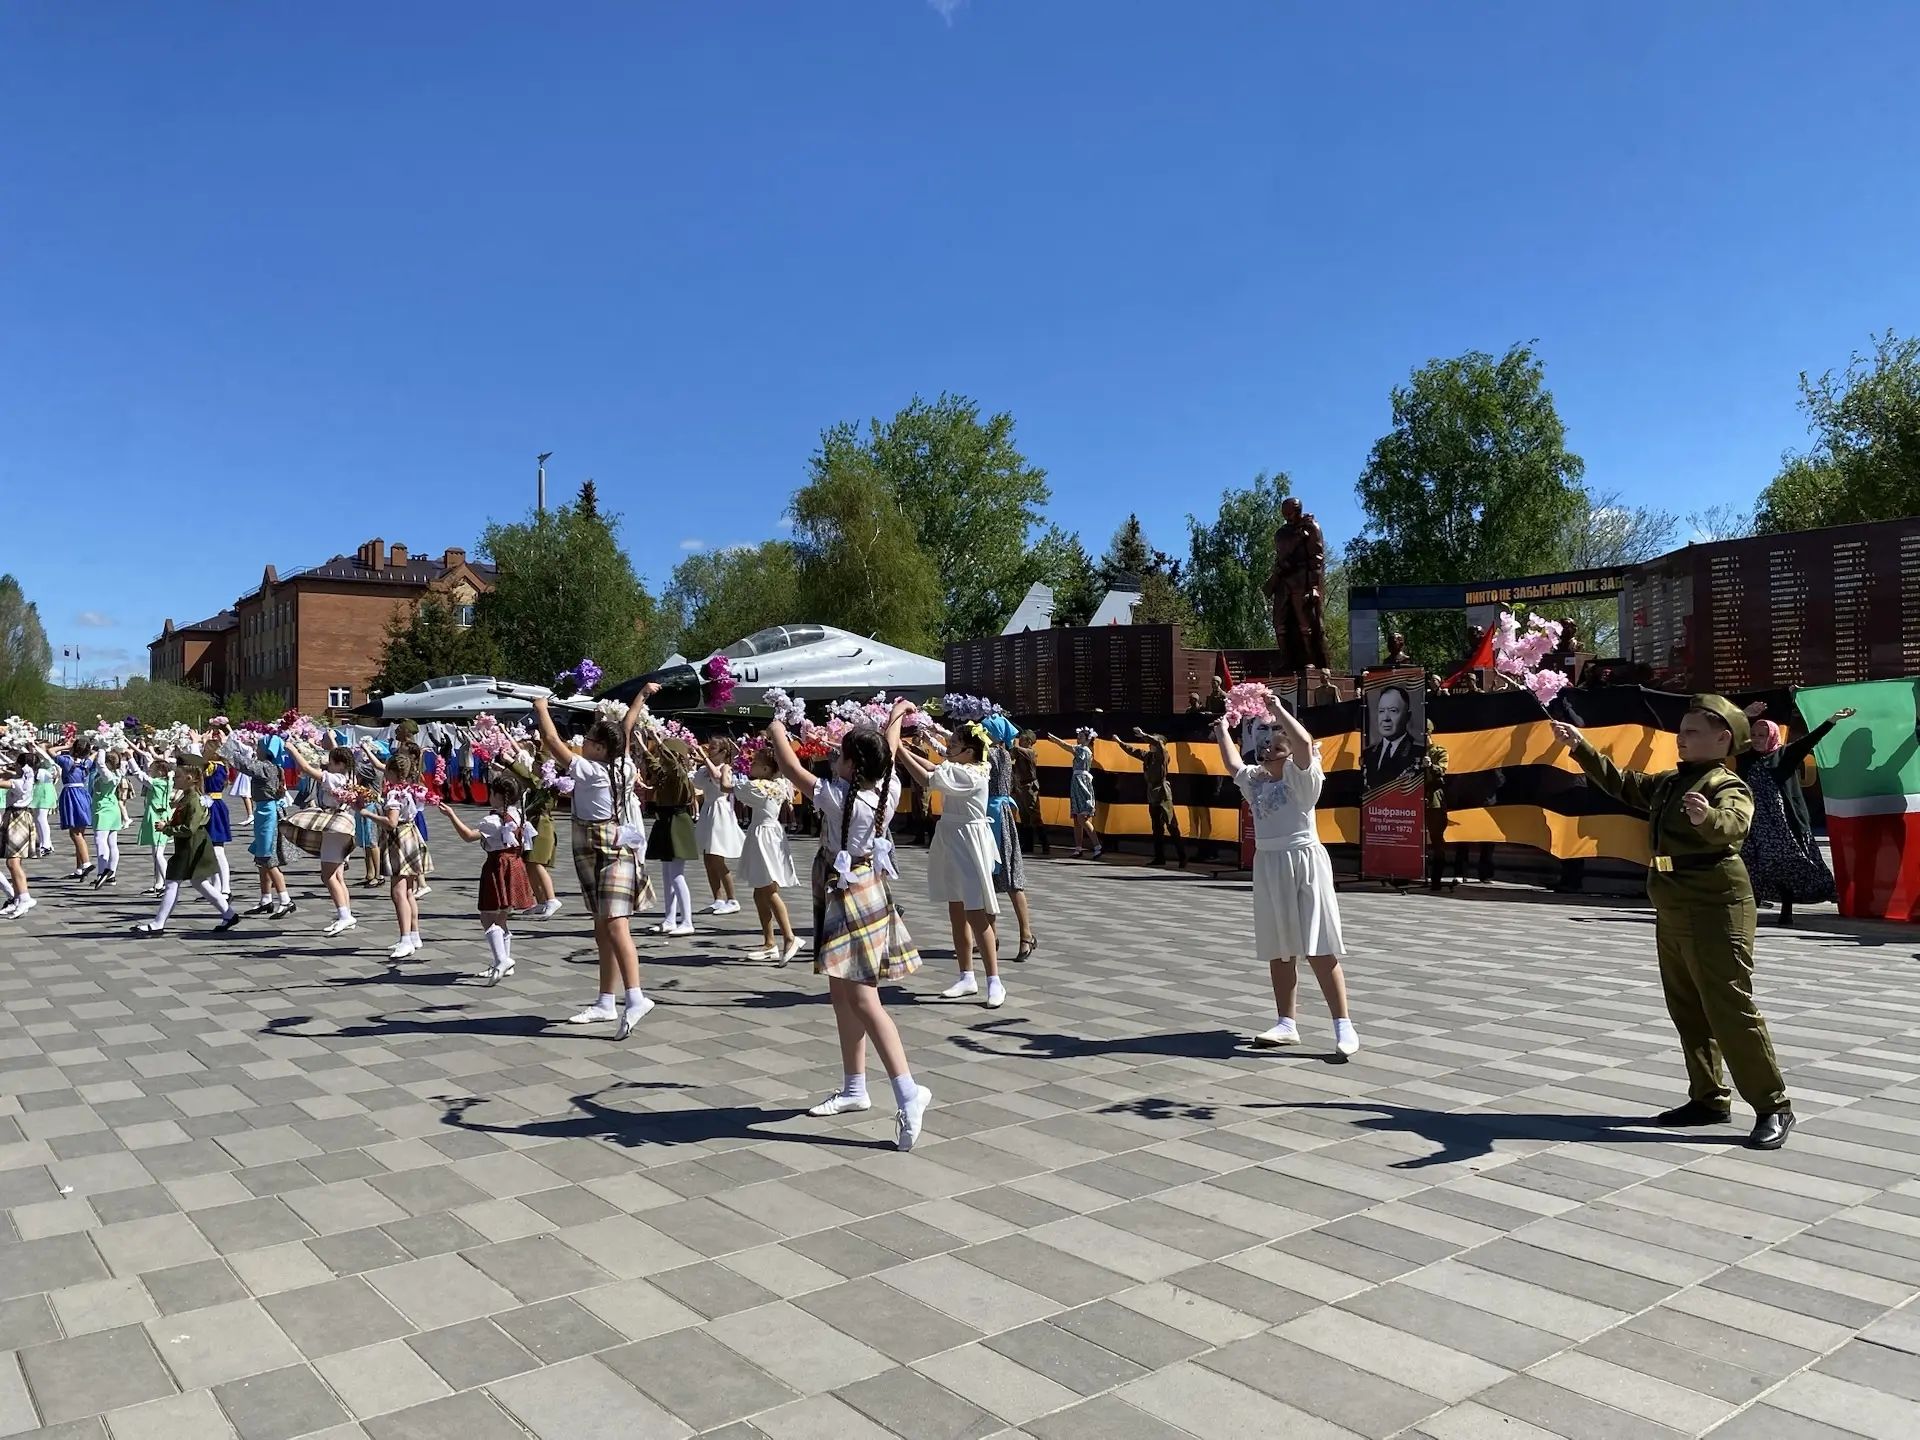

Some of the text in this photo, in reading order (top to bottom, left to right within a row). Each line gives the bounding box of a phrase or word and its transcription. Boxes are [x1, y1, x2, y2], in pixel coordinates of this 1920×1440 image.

[1499, 588, 1512, 601] НЕ
[1585, 578, 1600, 592] НЕ
[1600, 576, 1624, 591] ЗАБ
[1368, 807, 1416, 817] Шафранов
